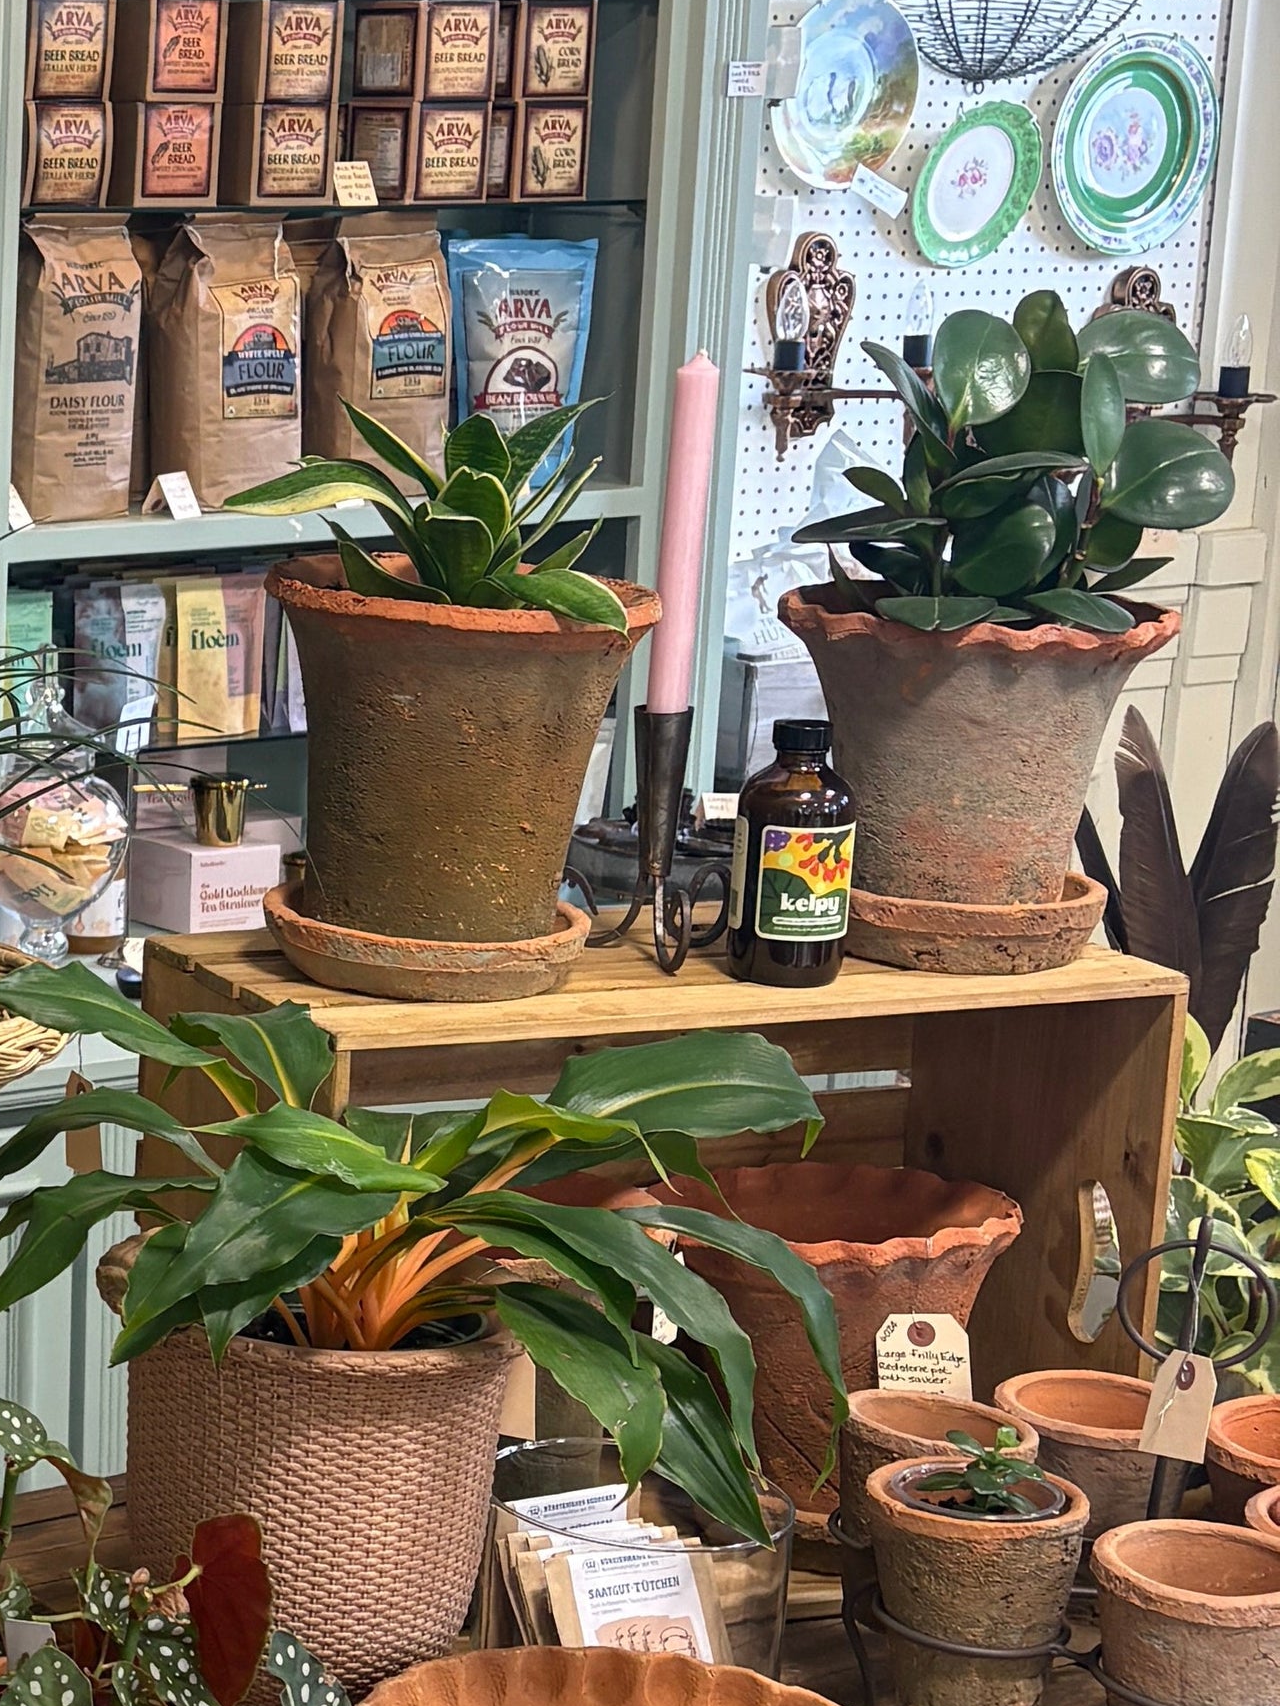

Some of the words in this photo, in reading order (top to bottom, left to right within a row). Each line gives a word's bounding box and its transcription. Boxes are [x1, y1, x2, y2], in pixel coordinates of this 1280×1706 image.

[54, 10, 94, 27] ARVA
[175, 9, 203, 21] ARVA
[284, 16, 322, 31] ARVA
[443, 18, 480, 32] ARVA
[545, 18, 576, 30] ARVA
[182, 37, 201, 48] BEER
[44, 49, 67, 62] BEER
[69, 49, 99, 62] BREAD
[178, 49, 205, 60] BREAD
[434, 52, 454, 63] BEER
[457, 51, 486, 63] BREAD
[558, 46, 581, 56] CORN
[274, 54, 295, 65] BEER
[297, 54, 328, 66] BREAD
[557, 58, 582, 68] BREAD
[43, 63, 75, 73] ITALIAN
[53, 119, 92, 135] ARVA
[165, 114, 195, 127] ARVA
[276, 118, 314, 133] ARVA
[543, 119, 572, 132] ARVA
[435, 123, 472, 137] ARVA
[172, 143, 193, 153] BEER
[554, 147, 576, 157] CORN
[43, 157, 66, 169] BEER
[67, 157, 98, 169] BREAD
[167, 153, 196, 164] BREAD
[267, 154, 289, 165] BEER
[290, 154, 320, 165] BREAD
[425, 156, 448, 168] BEER
[449, 156, 479, 168] BREAD
[552, 159, 577, 169] BREAD
[42, 171, 73, 181] ITALIAN
[60, 271, 127, 294] ARVA
[376, 271, 407, 284] ARVA
[240, 283, 272, 294] ARVA
[68, 294, 102, 309] FLOUR
[106, 295, 129, 306] MILL
[497, 298, 552, 320] ARVA
[387, 344, 436, 363] FLOUR
[238, 361, 285, 381] FLOUR
[50, 396, 88, 410] DAISY
[90, 394, 126, 409] FLOUR
[190, 628, 239, 651] floèm
[199, 887, 224, 900] Gold
[780, 893, 840, 916] kelpy
[877, 1348, 907, 1362] Large
